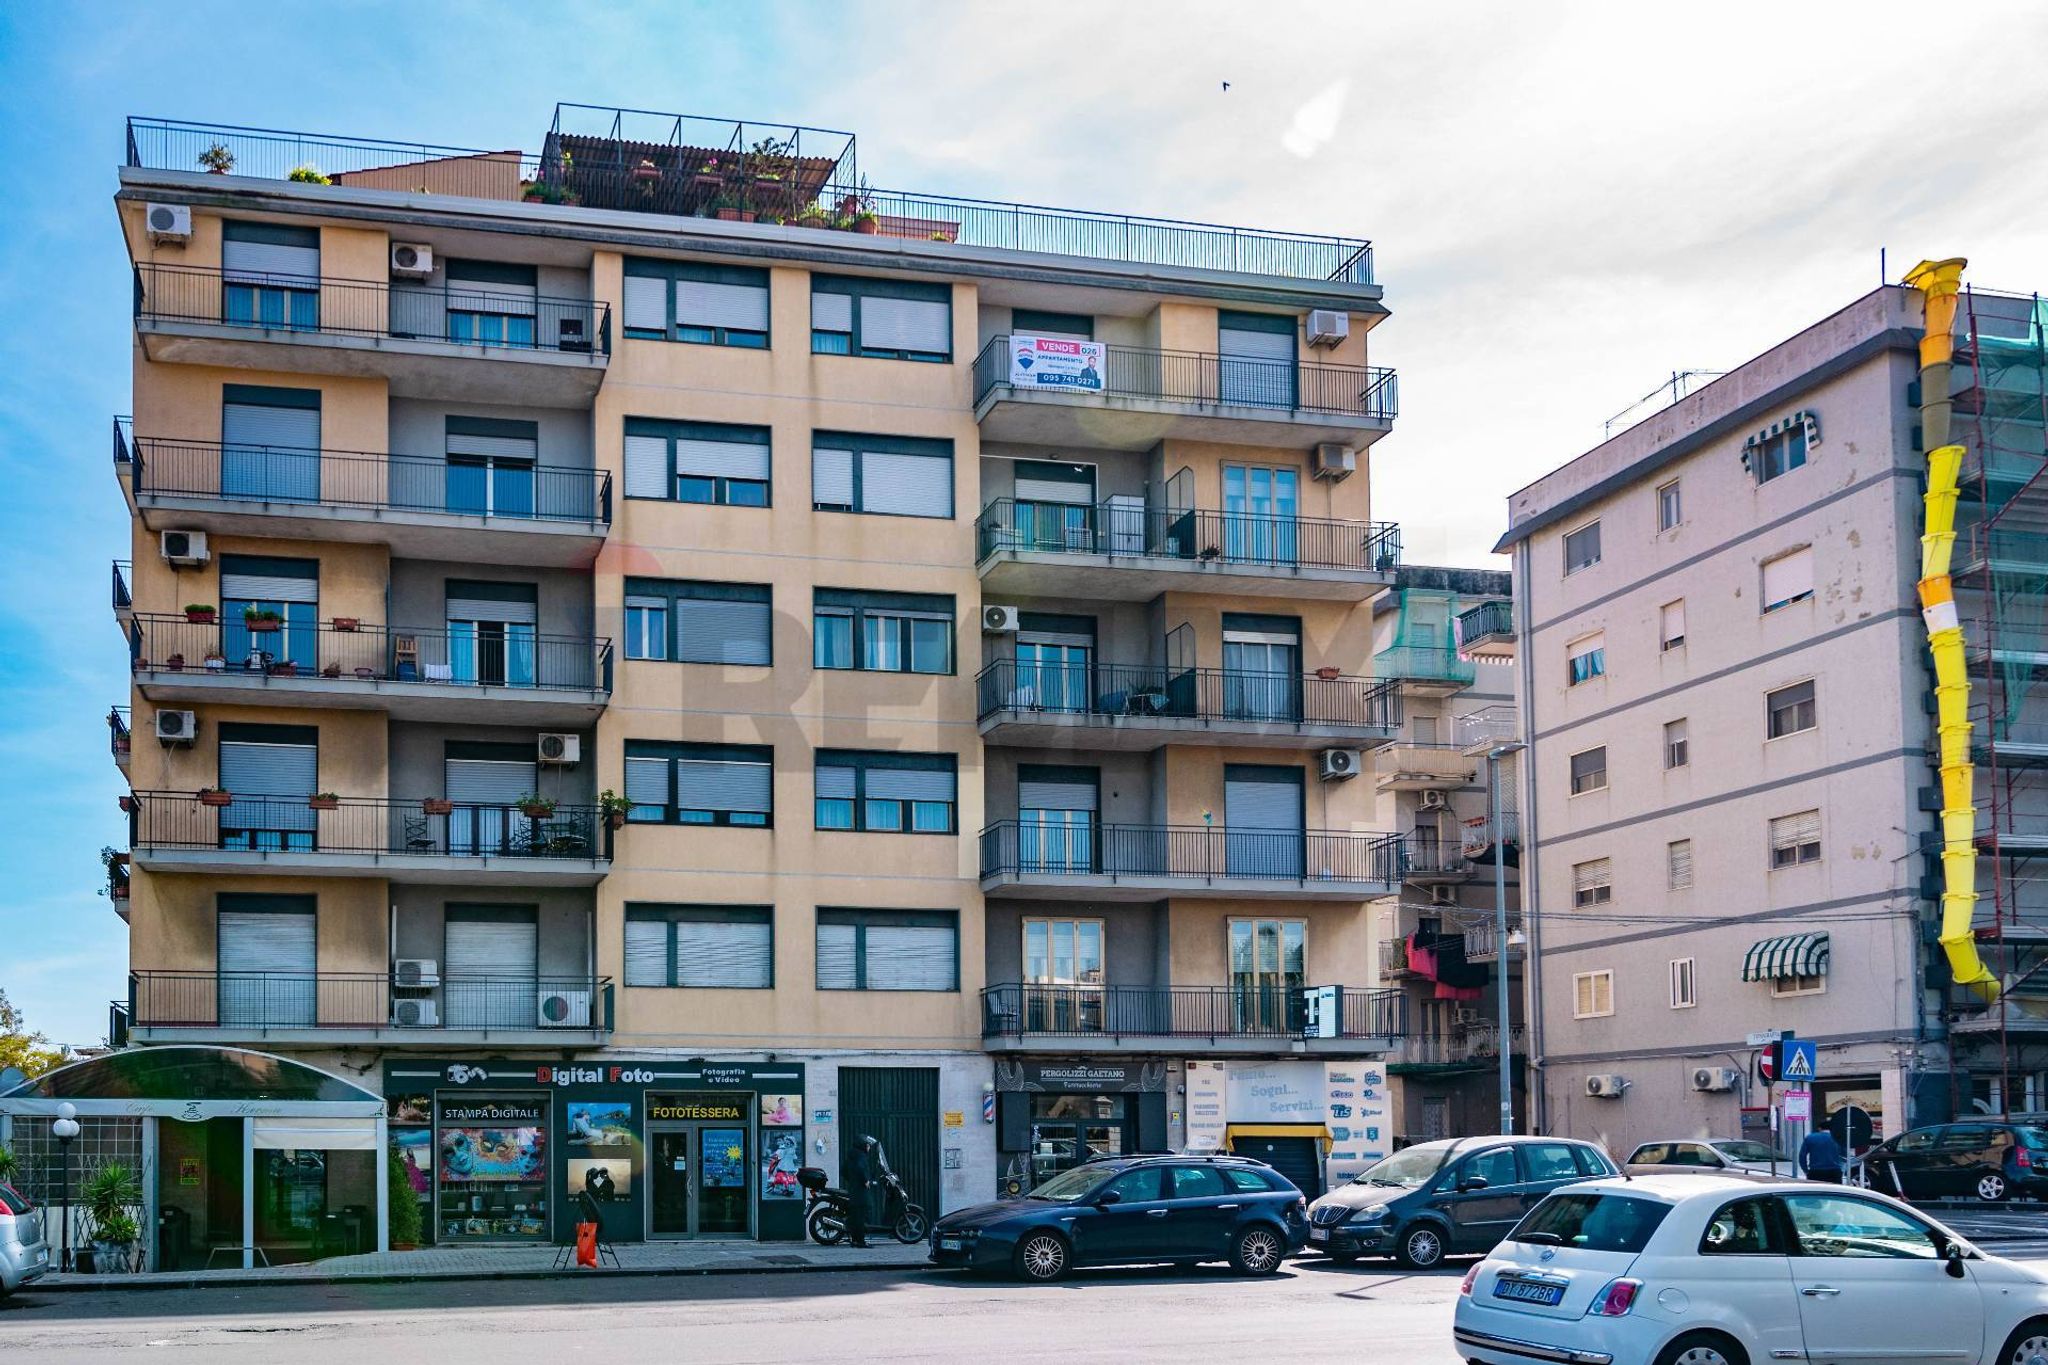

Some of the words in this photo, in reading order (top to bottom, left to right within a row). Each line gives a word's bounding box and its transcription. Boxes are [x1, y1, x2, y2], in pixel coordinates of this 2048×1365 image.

[1041, 342, 1075, 353] VENDE
[1037, 354, 1083, 364] APPARTAMENTO
[1062, 375, 1075, 383] 741
[1077, 377, 1095, 386] 0271
[537, 1066, 603, 1086] Digital
[609, 1066, 654, 1083] Foto
[702, 1068, 746, 1077] Fotografia
[1040, 1070, 1087, 1078] PERGOLIZZI
[1087, 1070, 1125, 1078] GAETANO
[445, 1109, 489, 1119] STAMPA
[491, 1109, 539, 1119] DIGITALE
[653, 1106, 740, 1119] FOTOTESSERA
[1517, 1284, 1554, 1301] 872BR
